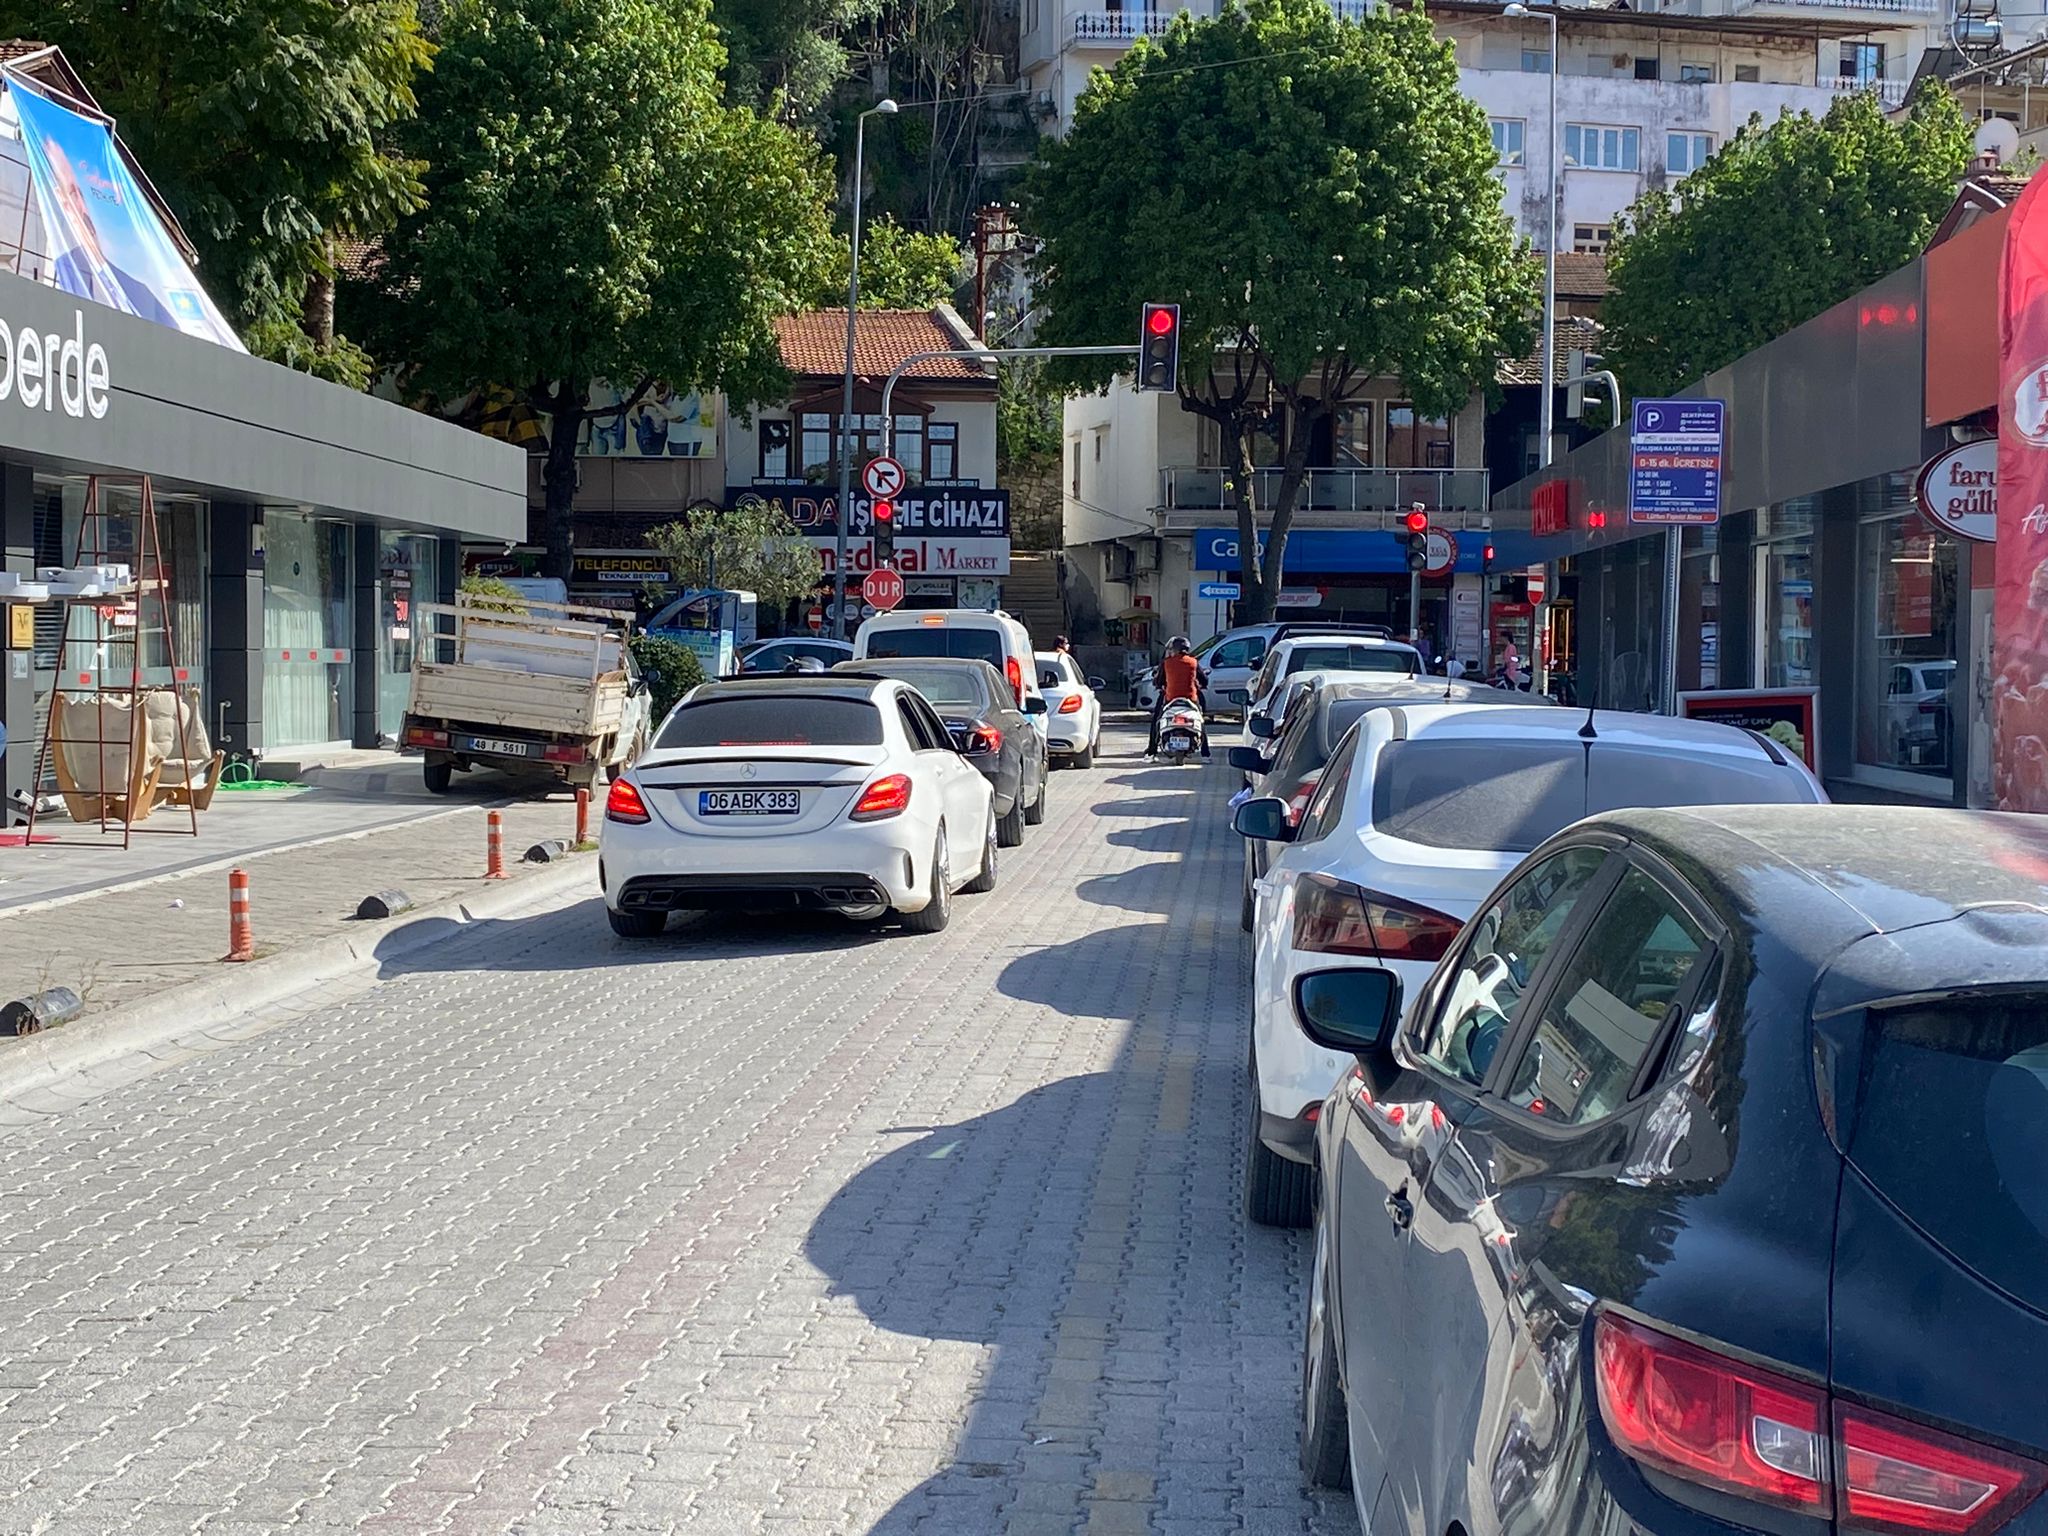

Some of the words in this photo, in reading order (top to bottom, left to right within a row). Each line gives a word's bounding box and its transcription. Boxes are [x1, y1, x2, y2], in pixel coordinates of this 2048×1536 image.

[1647, 412, 1660, 427] P
[1673, 457, 1714, 468] ÜCRETSİZ
[1949, 462, 1998, 487] faru
[928, 492, 1004, 528] CİHAZI
[1947, 490, 1998, 520] güll
[817, 541, 927, 571] medkal
[866, 582, 900, 598] DUR
[503, 743, 525, 754] 5611
[709, 792, 798, 809] 06ABK383
